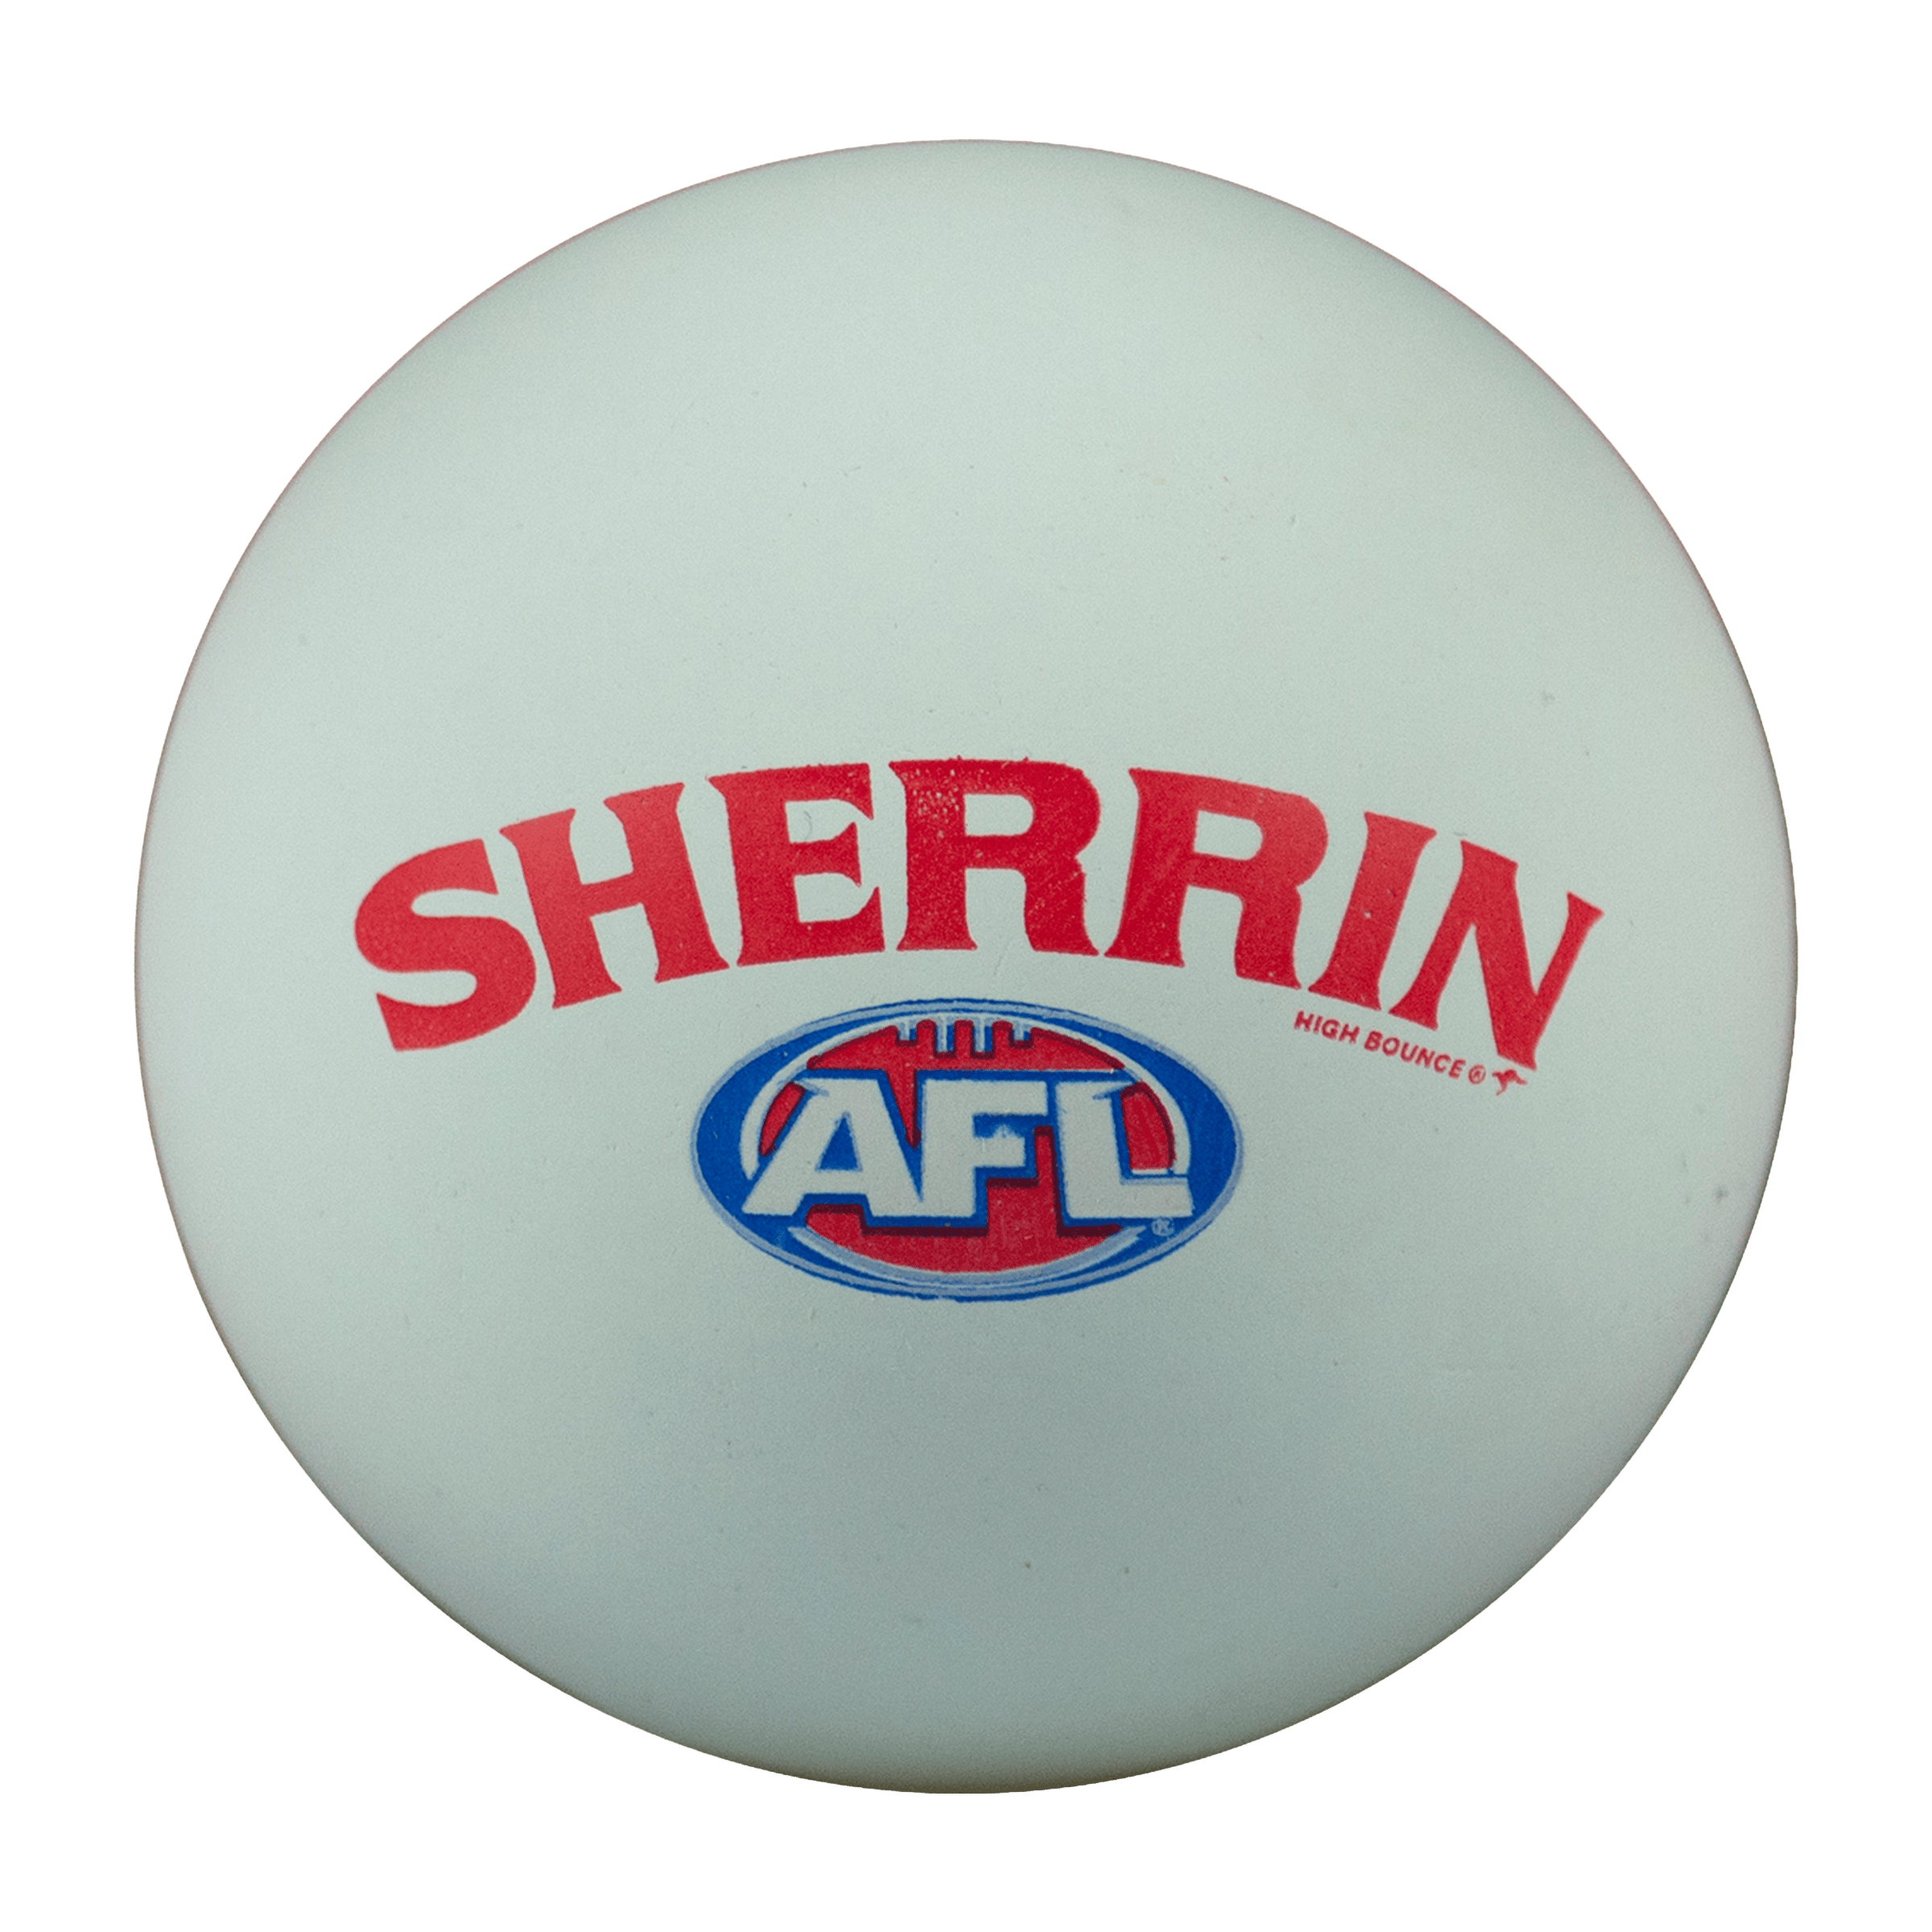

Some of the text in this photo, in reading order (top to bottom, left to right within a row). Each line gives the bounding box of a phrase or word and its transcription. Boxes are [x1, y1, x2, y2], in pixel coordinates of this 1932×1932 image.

[355, 756, 1604, 1070] SHERRIN
[1294, 1010, 1360, 1044] HIGH
[741, 1075, 1193, 1218] AFL
